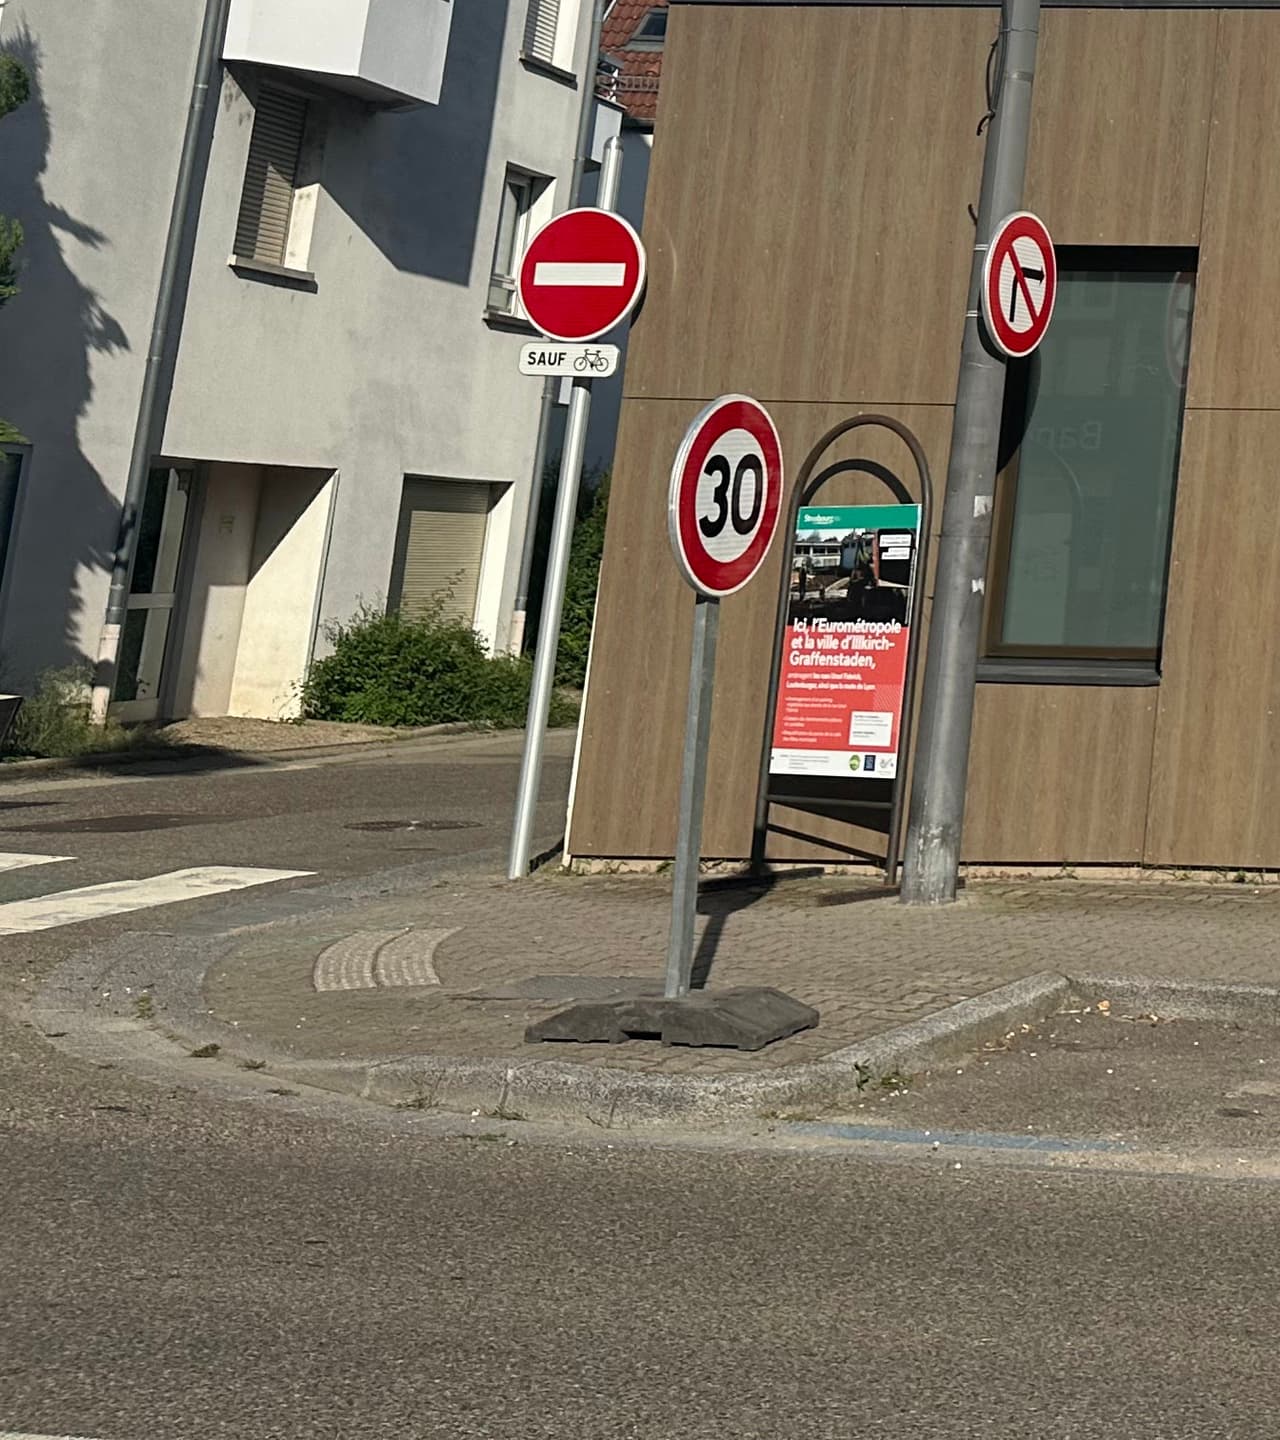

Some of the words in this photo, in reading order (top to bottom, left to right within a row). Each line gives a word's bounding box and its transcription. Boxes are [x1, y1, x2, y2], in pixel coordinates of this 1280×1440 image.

[527, 351, 567, 366] SAUF
[699, 453, 763, 538] 30
[793, 617, 809, 634] Ici,
[791, 636, 803, 649] et
[804, 635, 815, 650] la
[816, 635, 838, 650] ville
[789, 650, 876, 669] Graffenstaden,
